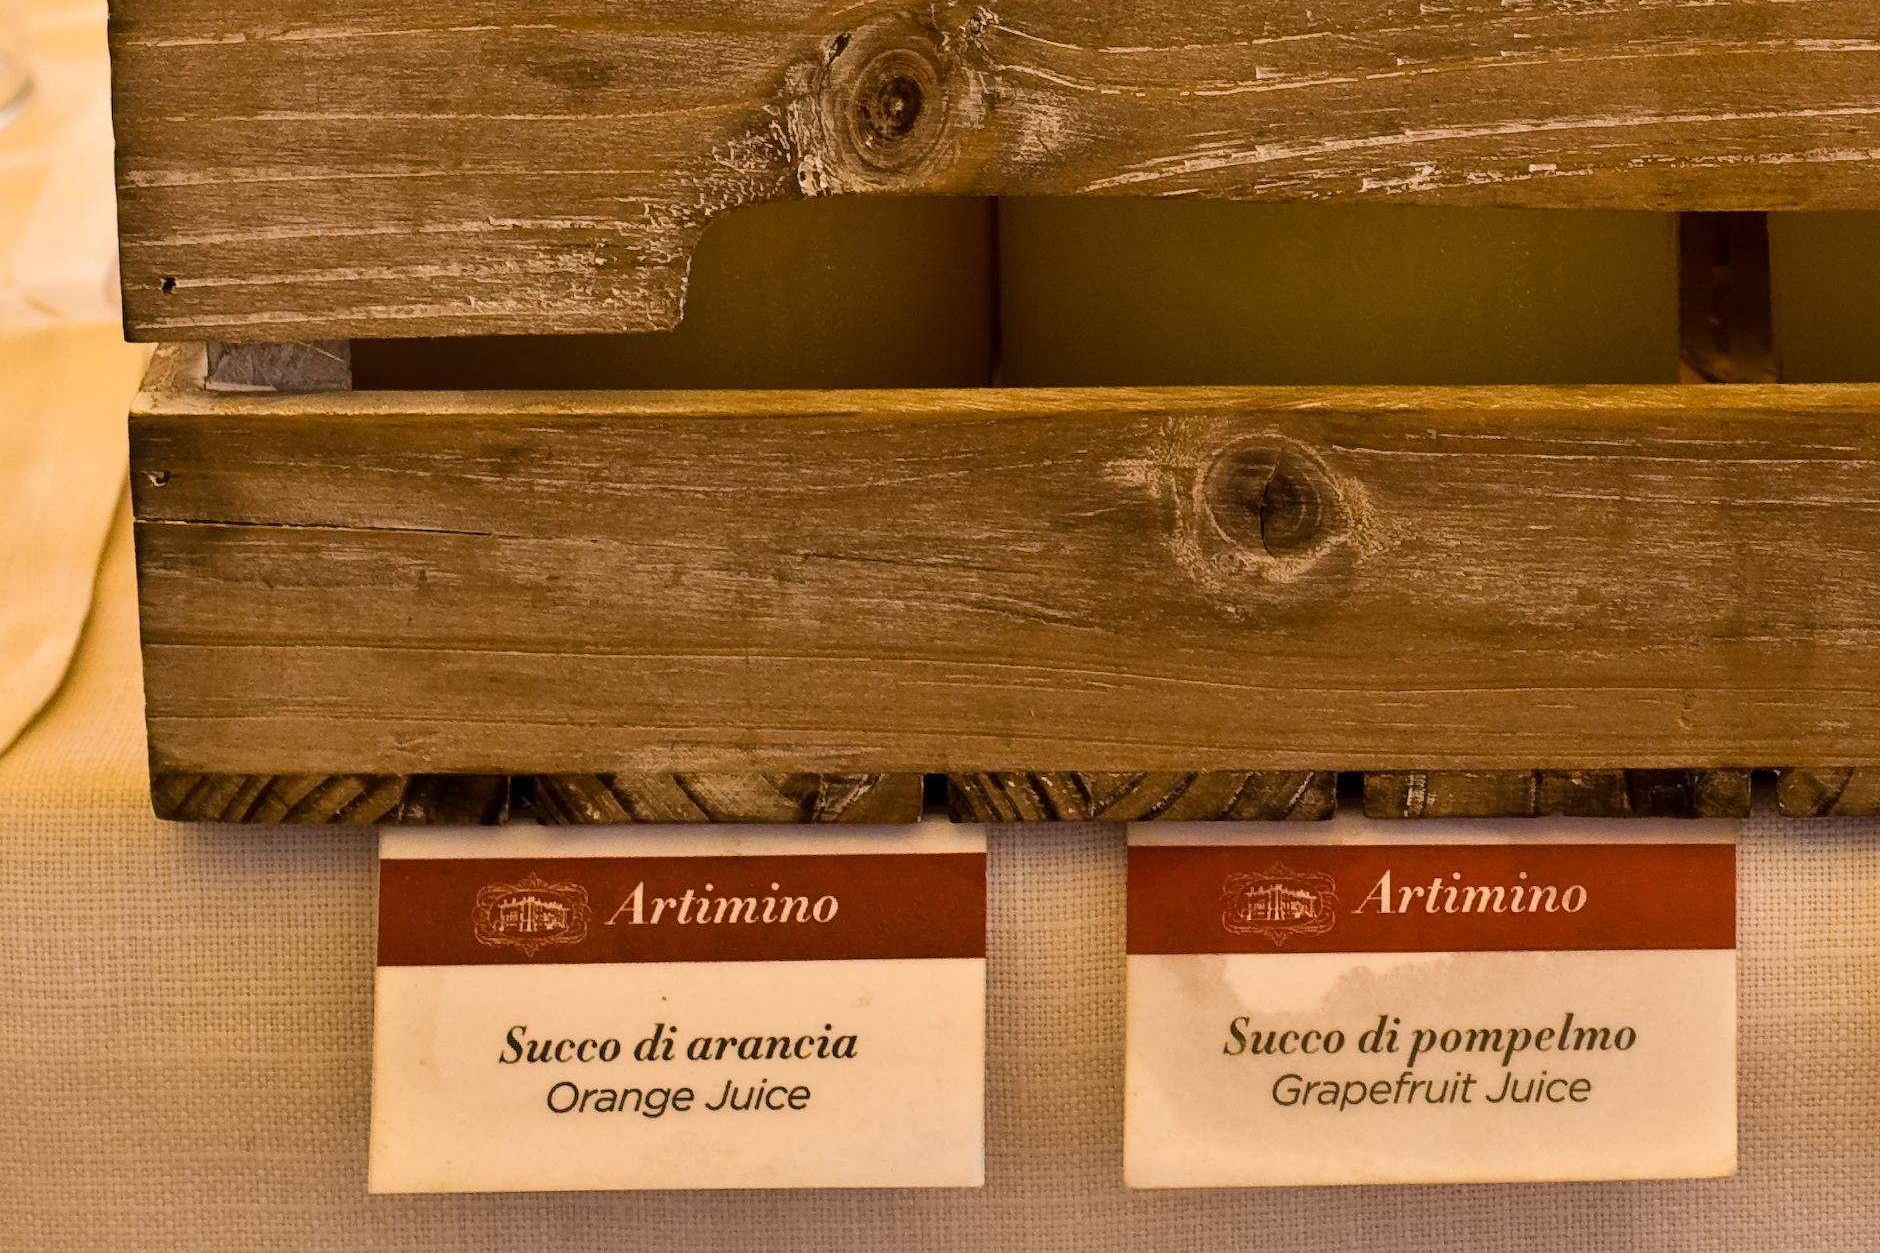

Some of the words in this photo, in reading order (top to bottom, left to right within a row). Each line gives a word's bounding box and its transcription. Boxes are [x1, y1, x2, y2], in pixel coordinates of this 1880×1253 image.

[605, 880, 839, 927] Artimino
[1351, 869, 1587, 915] Artimino
[499, 1025, 622, 1065] Succo
[634, 1023, 676, 1062] di
[687, 1023, 858, 1062] arancia
[1223, 1015, 1345, 1056] Succo
[1358, 1015, 1401, 1053] di
[1406, 1012, 1637, 1067] pompelmo
[547, 1080, 695, 1118] Orange
[705, 1078, 811, 1112] Juice
[1272, 1070, 1477, 1112] Grapefruit
[1486, 1070, 1592, 1104] Juice
